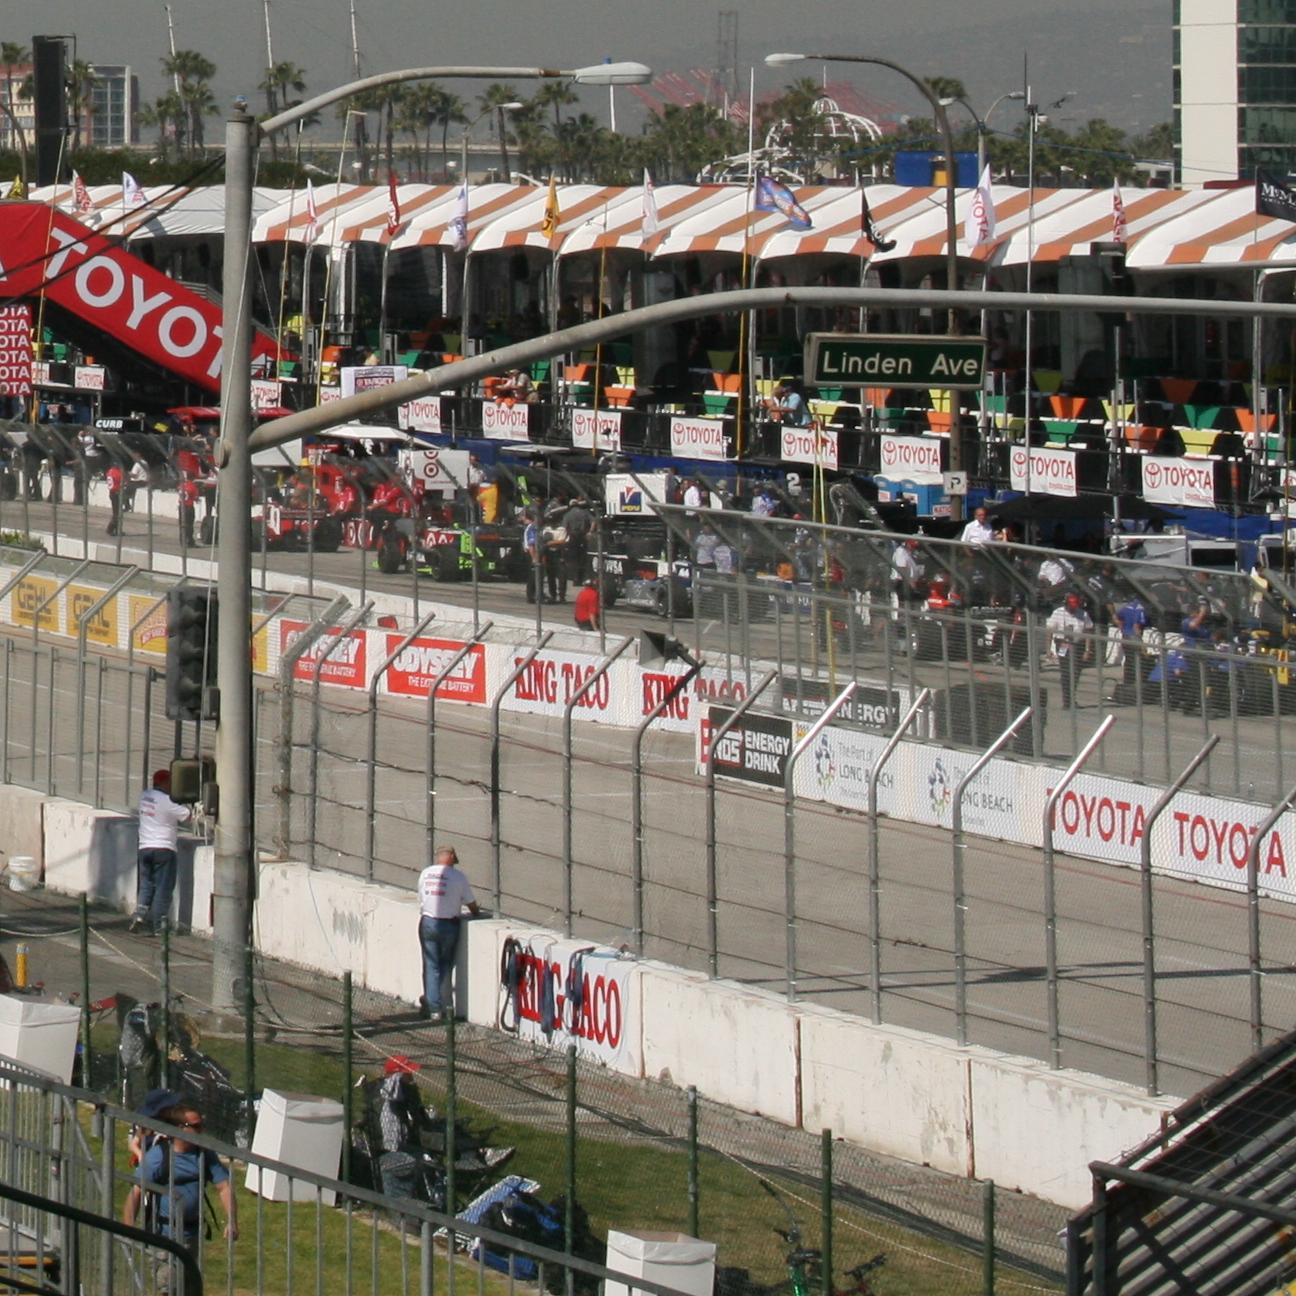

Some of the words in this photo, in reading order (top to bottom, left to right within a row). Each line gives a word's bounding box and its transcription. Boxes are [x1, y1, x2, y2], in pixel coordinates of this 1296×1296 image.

[823, 351, 912, 375] Linden
[930, 353, 978, 376] Ave
[96, 419, 123, 429] CURB
[495, 409, 528, 426] TOYOTA
[685, 426, 721, 445] TOYOTA
[898, 444, 940, 464] TOYOTA
[1030, 457, 1075, 480] TOYOTA
[1163, 467, 1212, 490] TOYOTA
[515, 657, 557, 703] KING
[562, 663, 609, 710] TACO
[744, 730, 790, 756] ENERGY
[745, 754, 781, 775] DRINK
[982, 793, 1014, 813] BEACH
